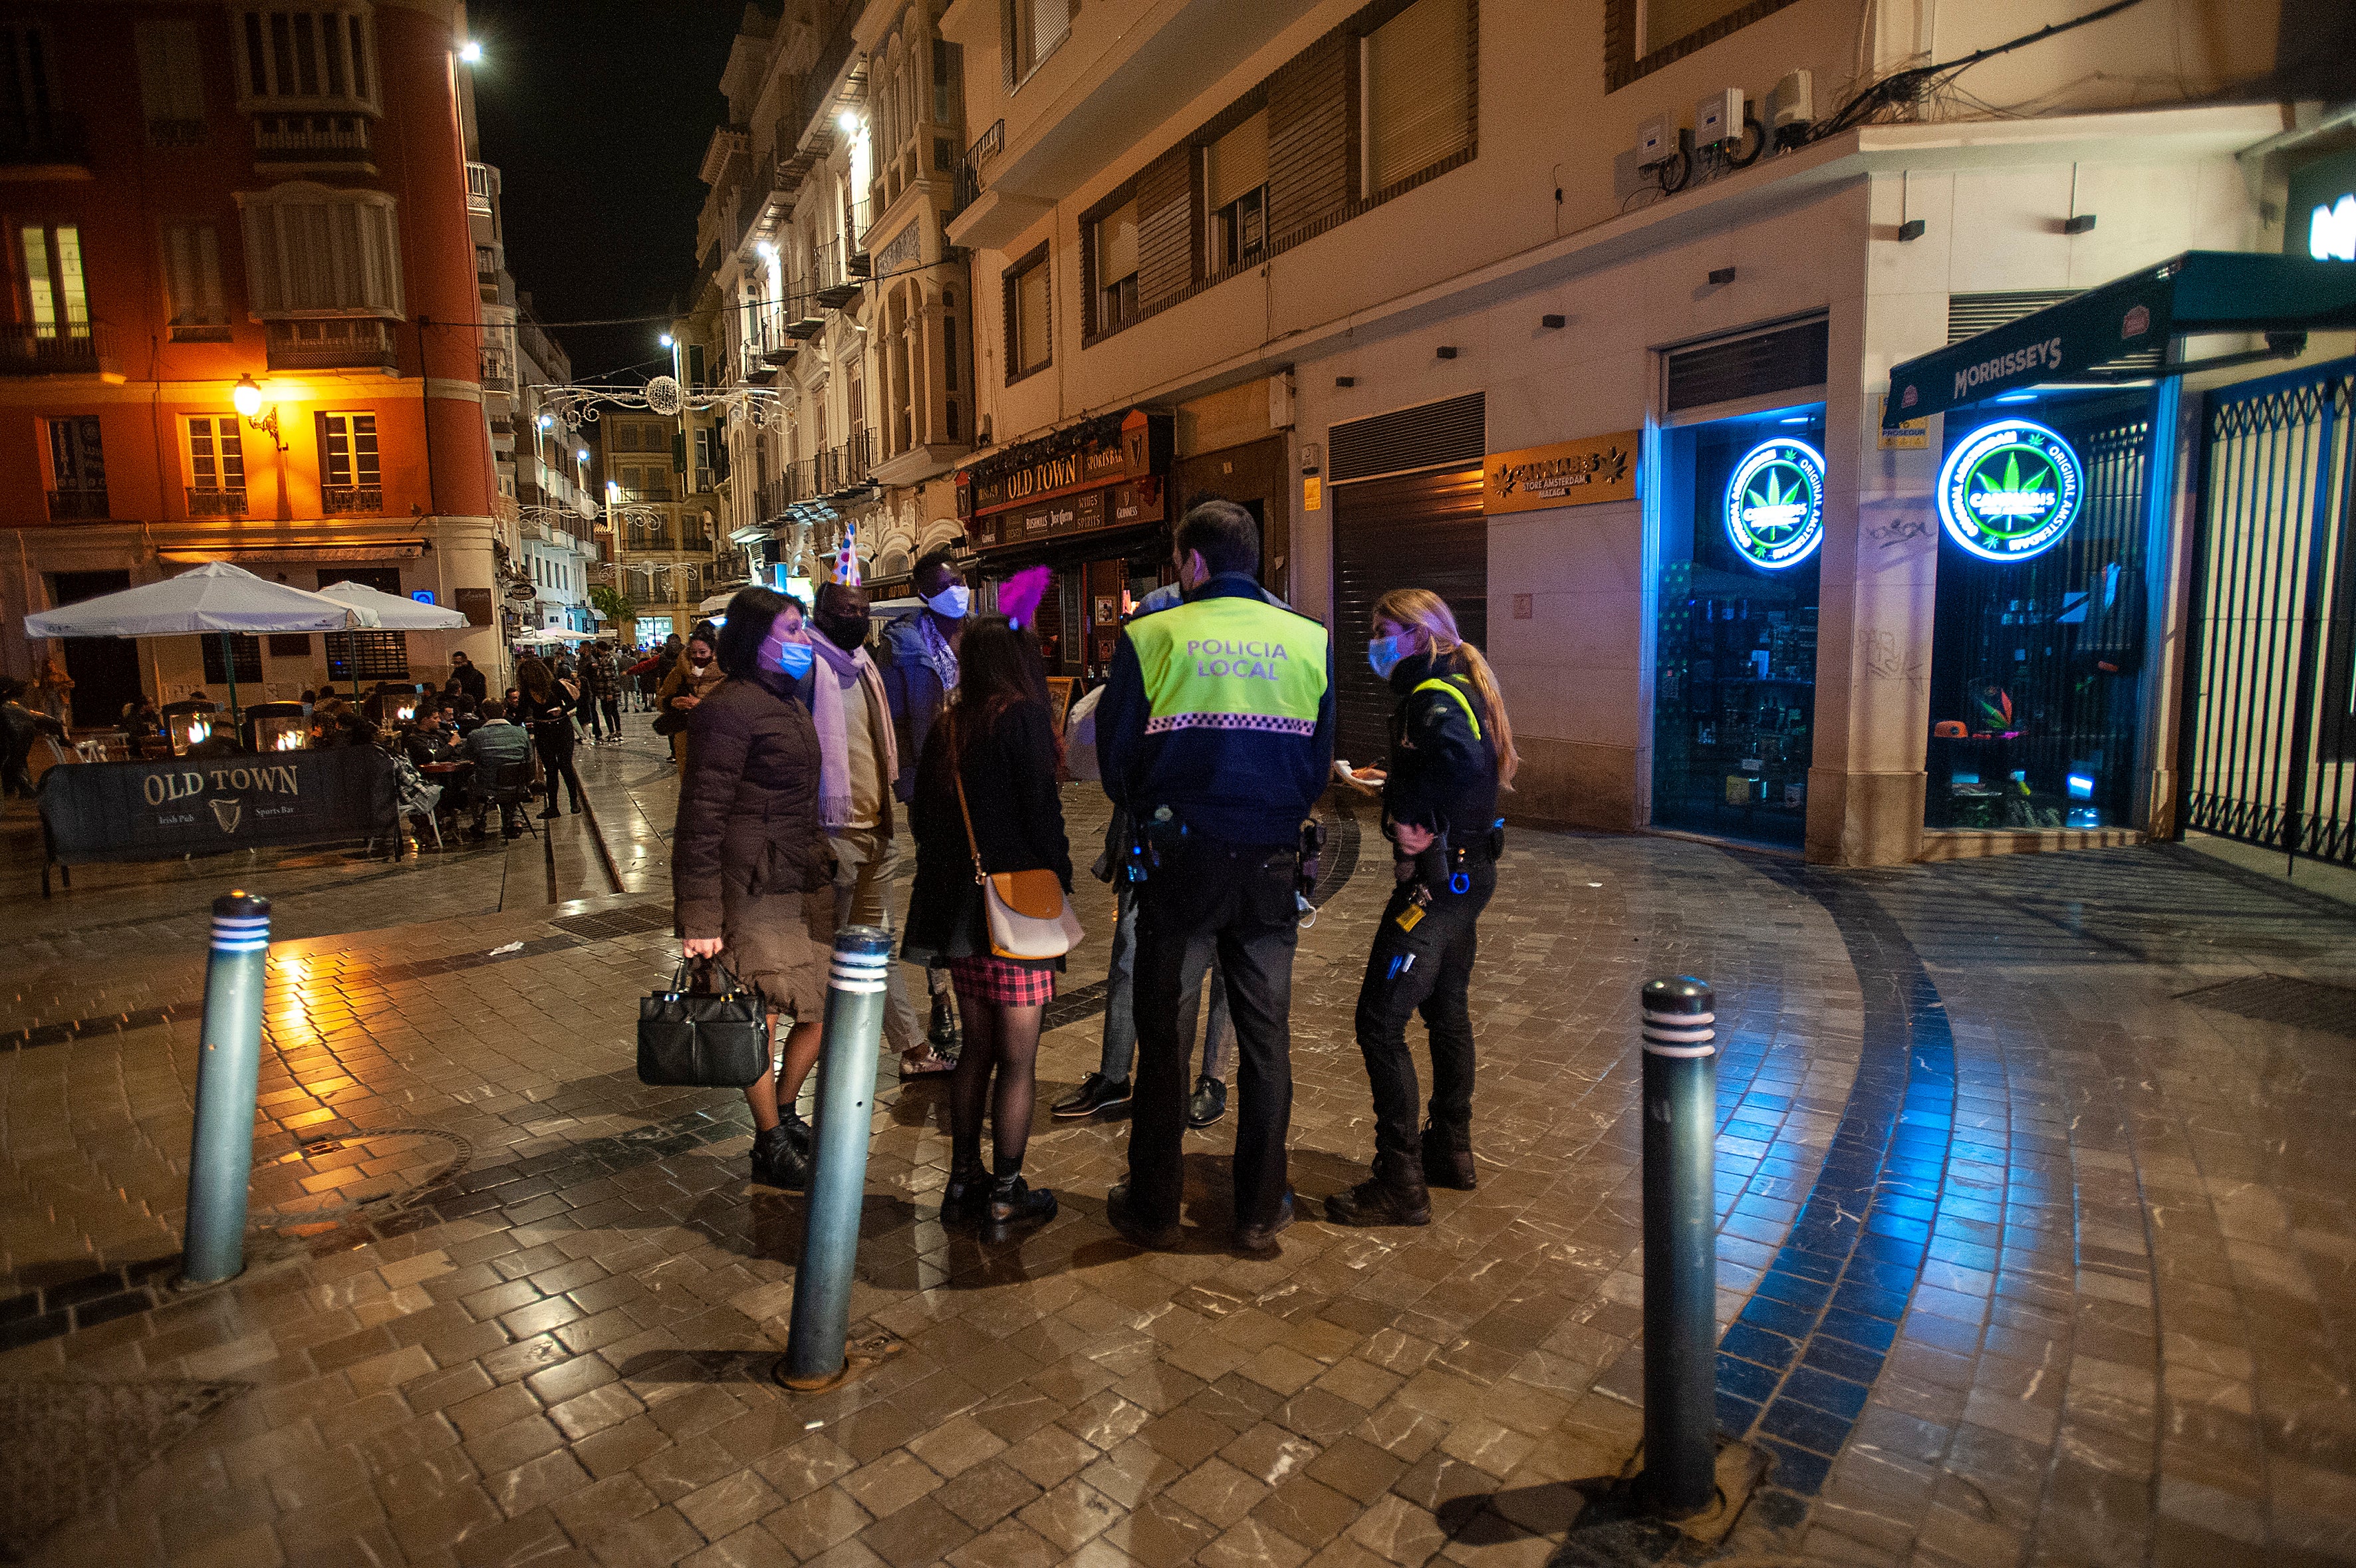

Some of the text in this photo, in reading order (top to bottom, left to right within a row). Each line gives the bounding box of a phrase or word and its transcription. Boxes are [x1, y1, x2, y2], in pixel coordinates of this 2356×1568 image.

[1954, 337, 2061, 399] MORRISSEYS
[1087, 448, 1123, 471] SPORTS BAR
[2049, 446, 2075, 496] ORIGINAL
[1008, 468, 1032, 499] OLD
[1036, 454, 1076, 491] TOWN
[1523, 474, 1585, 491] STORE AMSTERDAM
[1799, 459, 1822, 506] ORIGINAL
[1078, 515, 1101, 529] SPIRITS
[2009, 499, 2073, 551] AMSTERDAM
[1188, 639, 1288, 660] POLICIA
[1198, 659, 1279, 681] LOCAL
[144, 765, 298, 806] OLD TOWN
[179, 814, 194, 823] Pub
[256, 807, 280, 817] Sports
